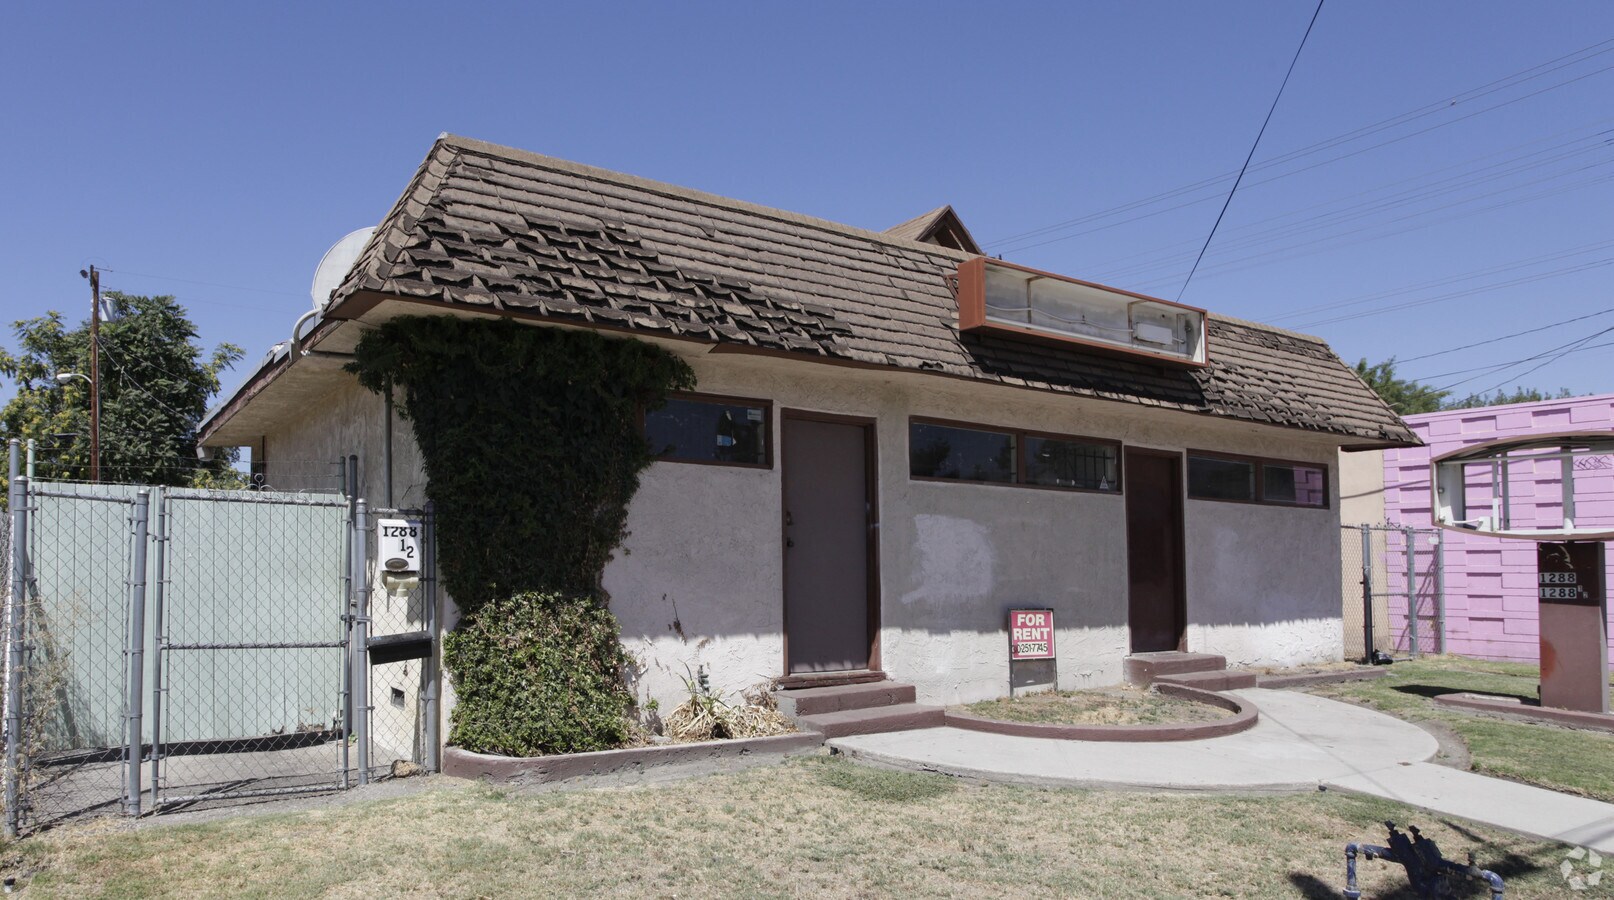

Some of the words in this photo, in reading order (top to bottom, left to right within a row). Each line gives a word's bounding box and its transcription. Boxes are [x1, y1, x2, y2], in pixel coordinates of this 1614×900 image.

[383, 527, 417, 538] 1288
[1540, 573, 1576, 583] 1288
[1540, 588, 1576, 598] 1288
[1017, 613, 1045, 626] FOR
[1013, 627, 1050, 640] RENT
